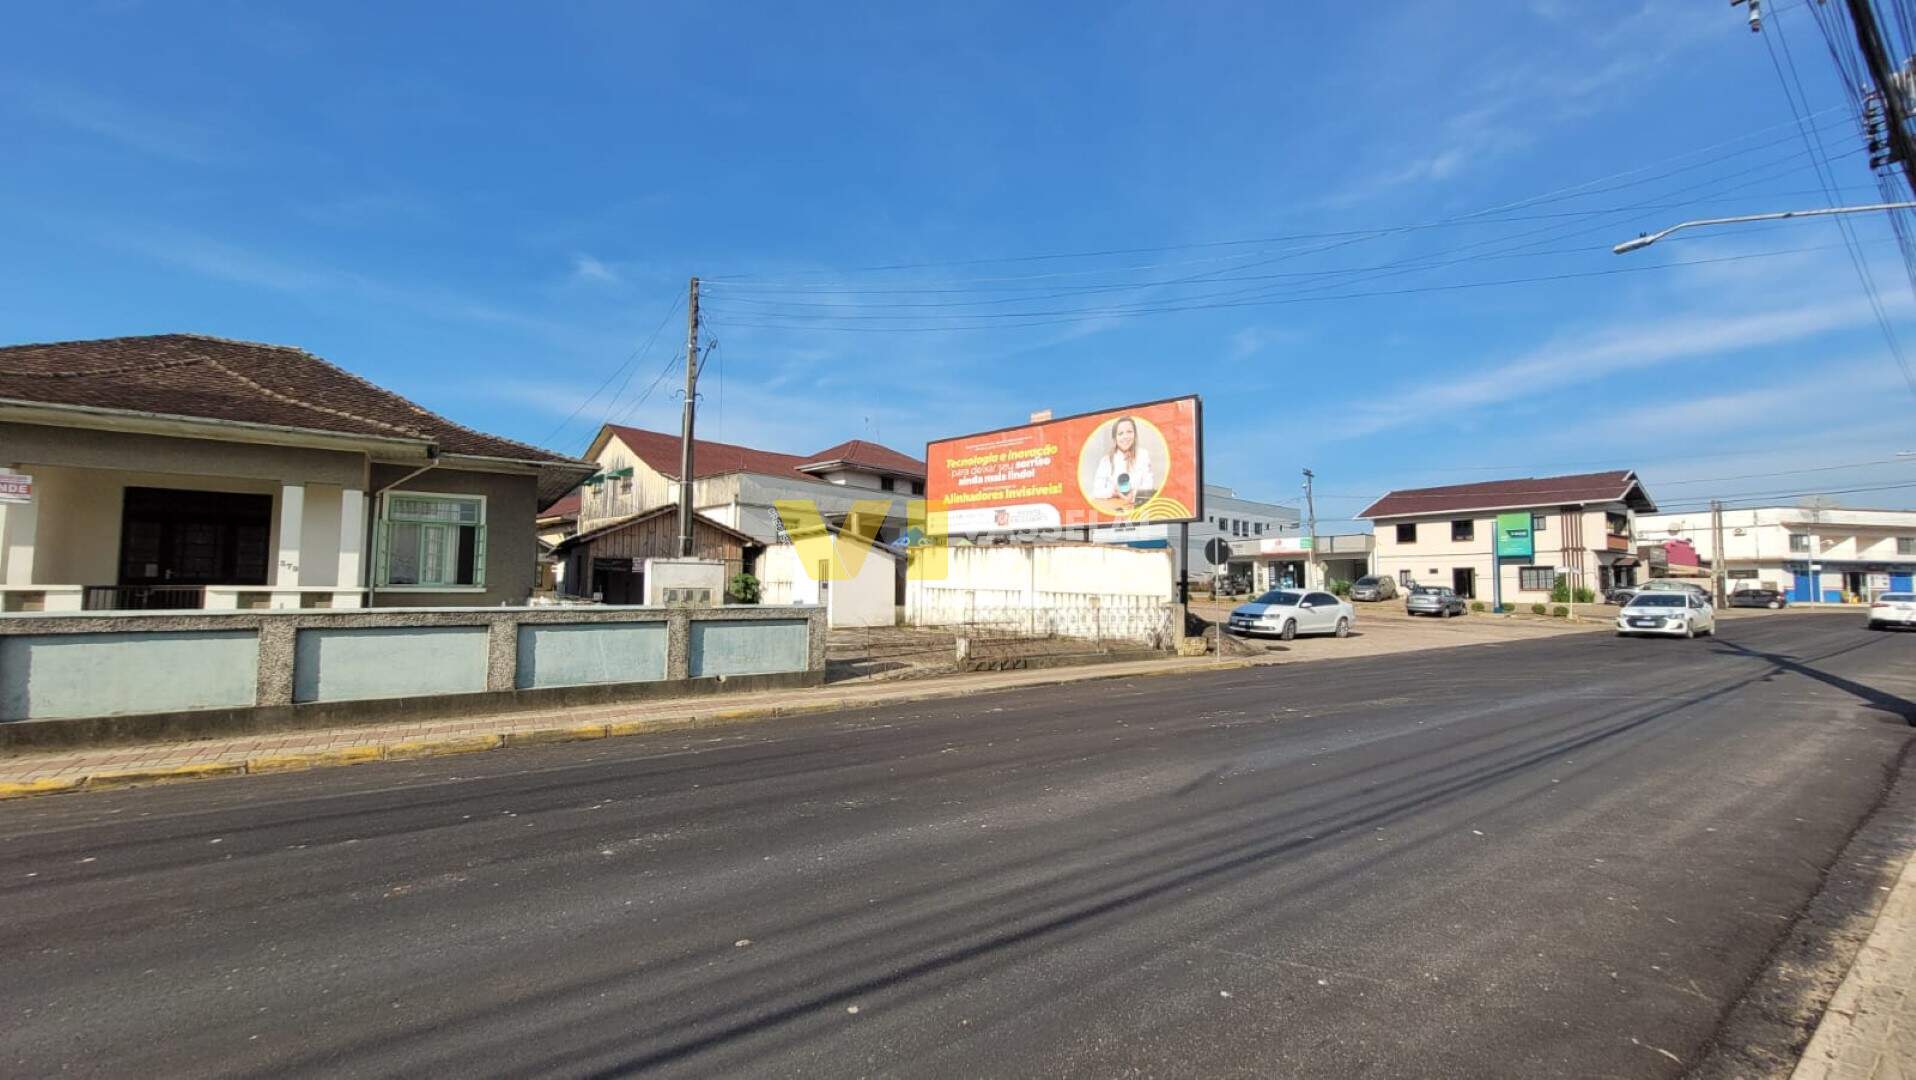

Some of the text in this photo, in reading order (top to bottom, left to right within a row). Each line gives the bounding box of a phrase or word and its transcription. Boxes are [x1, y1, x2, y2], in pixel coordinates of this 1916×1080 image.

[946, 452, 998, 468] Tecnologia
[958, 475, 983, 486] ainda
[984, 473, 1007, 483] mais
[943, 490, 1004, 505] Alinhadores
